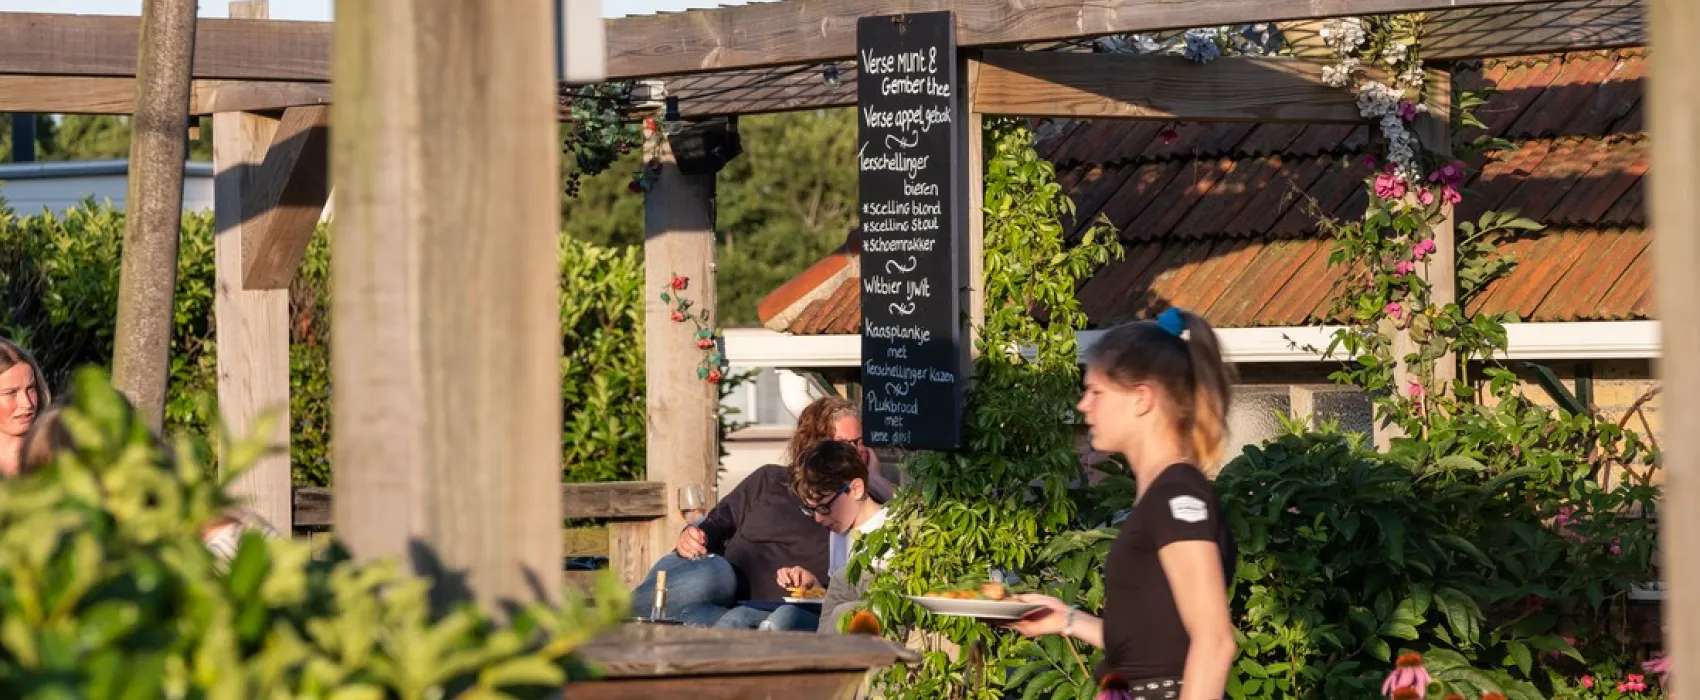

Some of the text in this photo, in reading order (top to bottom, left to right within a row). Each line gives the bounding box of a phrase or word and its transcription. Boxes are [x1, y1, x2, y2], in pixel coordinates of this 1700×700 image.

[861, 47, 895, 74] Verse
[928, 46, 937, 74] &
[881, 75, 951, 97] Gember thee
[863, 104, 894, 128] Verse
[857, 140, 930, 179] Terschellinger
[903, 178, 939, 196] bieren
[864, 316, 931, 346] Kaasplankje
[886, 344, 908, 359] met
[884, 414, 904, 427] met
